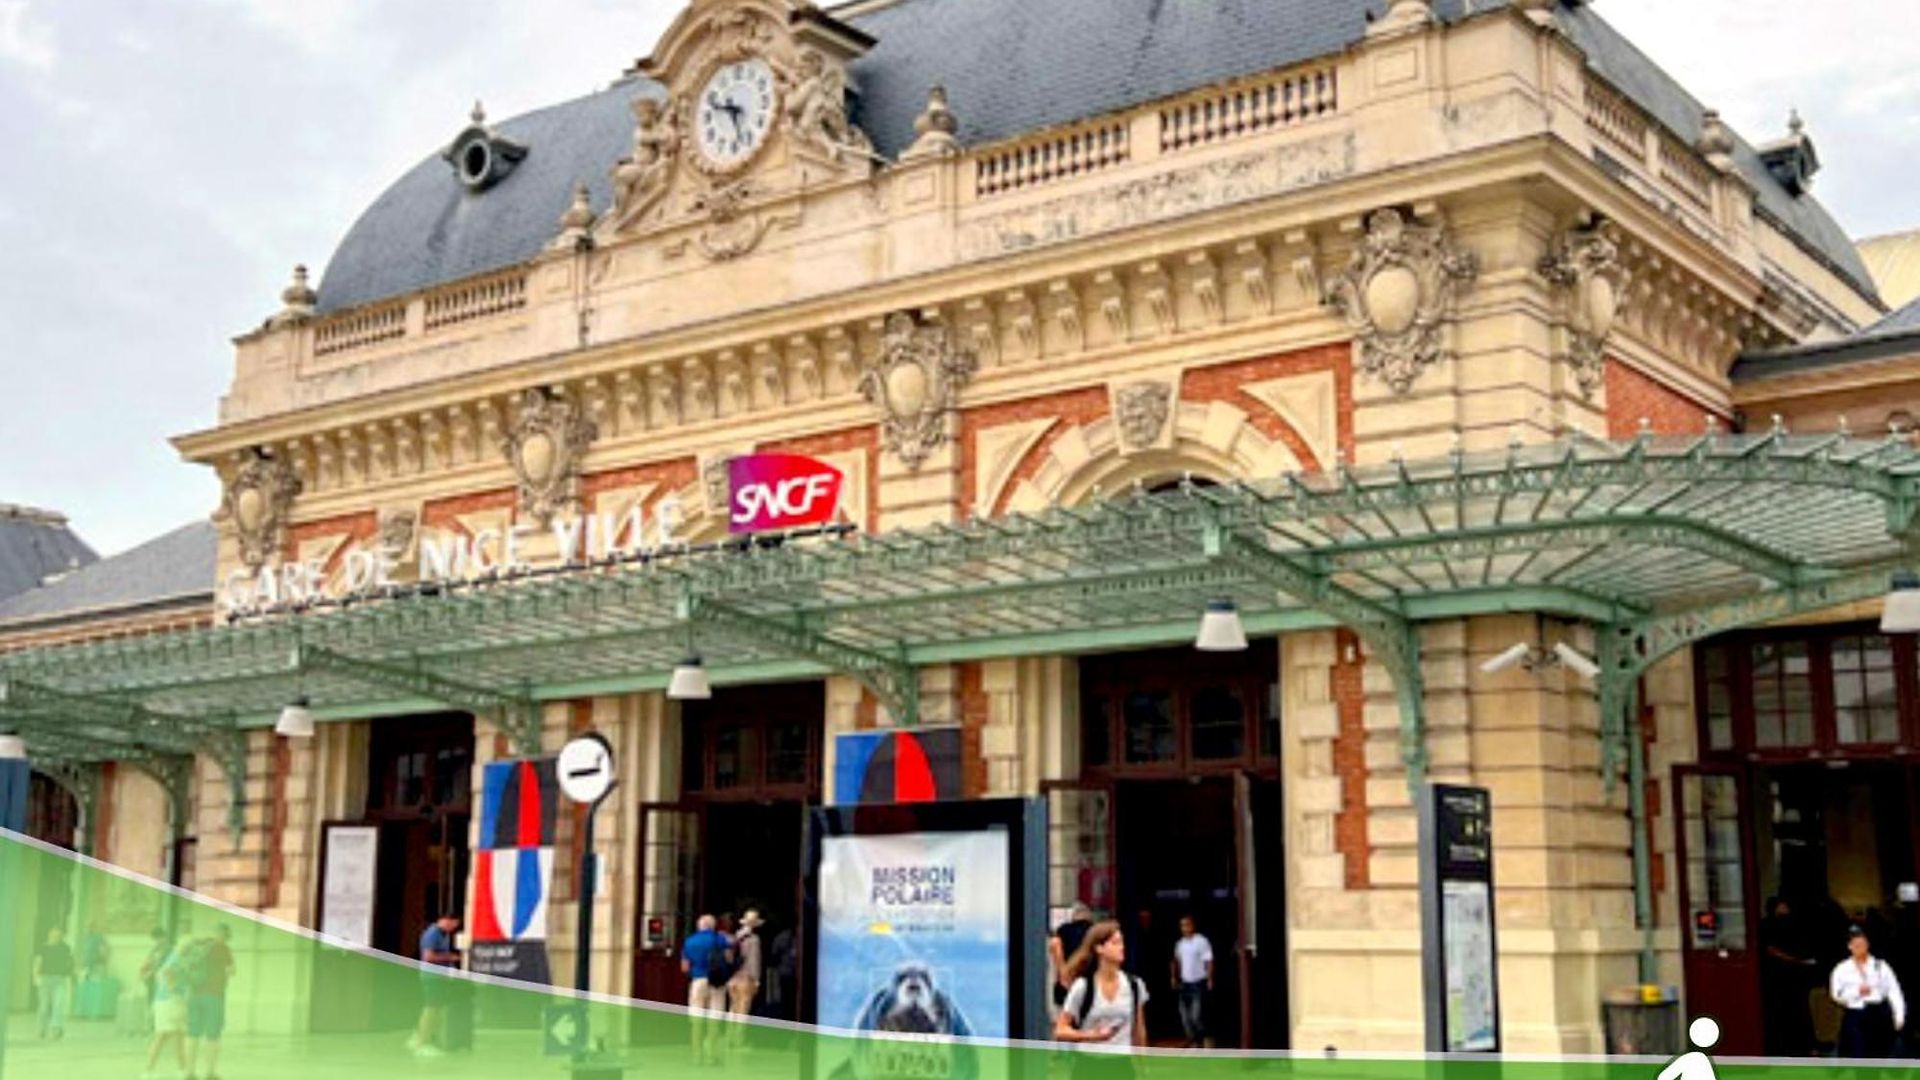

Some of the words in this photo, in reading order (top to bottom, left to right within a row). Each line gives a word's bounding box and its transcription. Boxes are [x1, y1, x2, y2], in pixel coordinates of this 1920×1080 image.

[732, 472, 834, 523] SNCF
[225, 558, 328, 609] GARE
[342, 547, 402, 594] DE
[419, 524, 532, 582] NICE
[551, 497, 683, 566] VILLE
[872, 866, 955, 884] MISSION
[872, 885, 955, 905] POLAIRE
